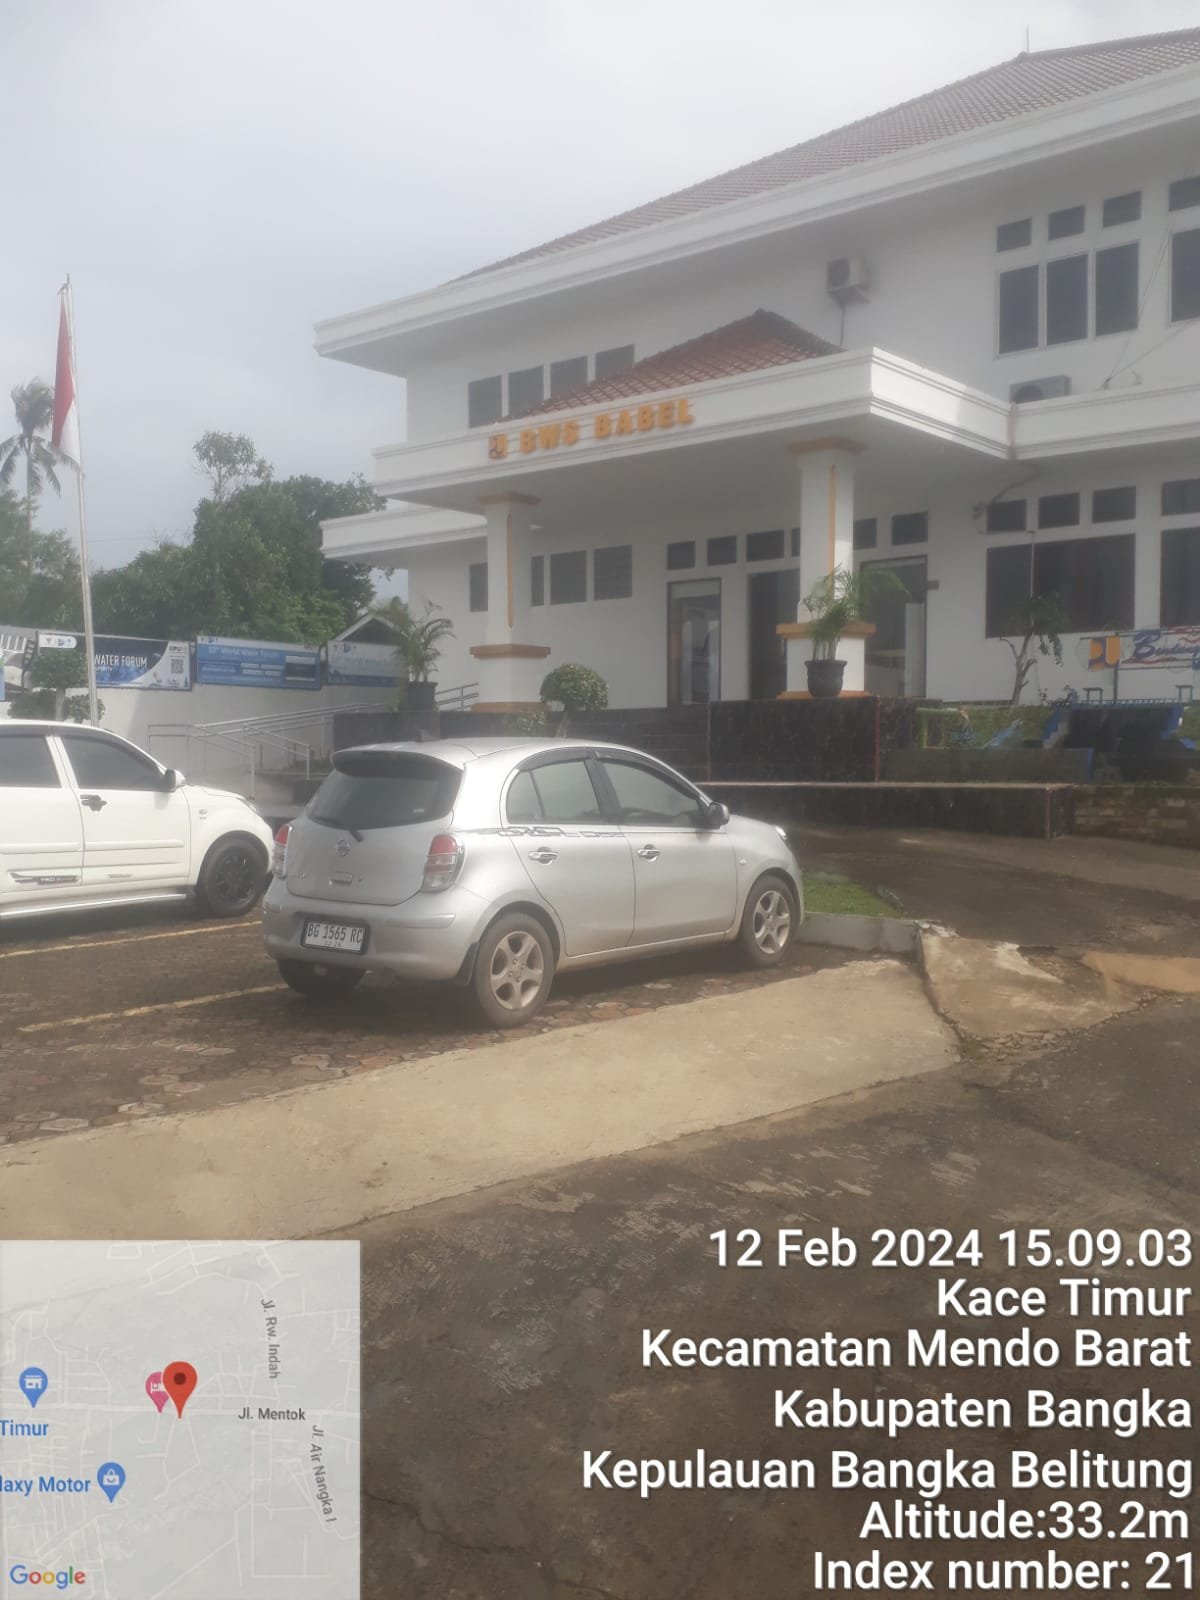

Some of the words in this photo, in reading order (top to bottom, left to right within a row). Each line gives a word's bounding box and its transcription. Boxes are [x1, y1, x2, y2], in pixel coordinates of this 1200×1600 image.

[520, 420, 580, 454] BWS
[595, 398, 693, 440] BABEL
[121, 655, 147, 669] FORUM
[307, 923, 320, 938] BG
[322, 925, 347, 941] 1565
[350, 928, 363, 943] RC
